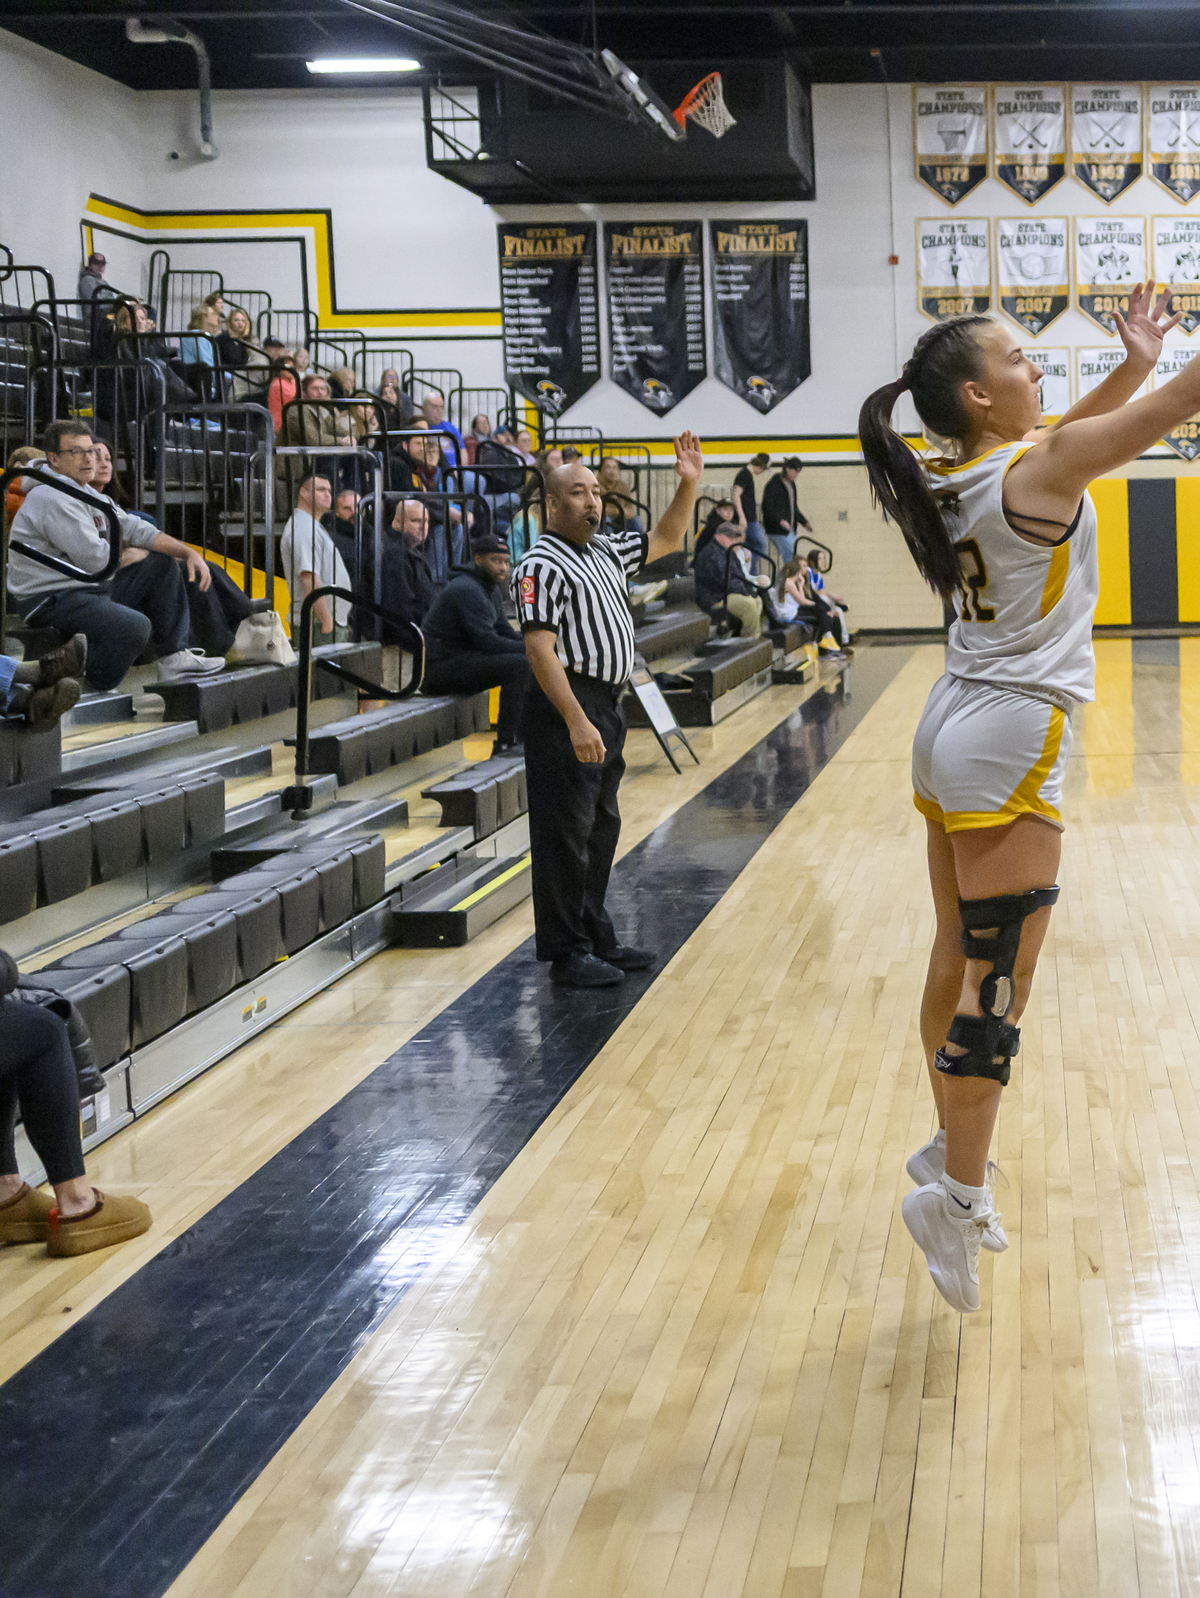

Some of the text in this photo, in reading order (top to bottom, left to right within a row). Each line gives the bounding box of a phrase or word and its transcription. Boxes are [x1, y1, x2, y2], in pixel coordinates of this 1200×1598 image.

[935, 91, 964, 100] STATE
[1014, 90, 1043, 100] STATE
[1091, 89, 1121, 99] STATE
[1169, 89, 1198, 99] STATE
[918, 101, 984, 116] CHAMPIONS
[997, 101, 1061, 115] CHAMPIONS
[1074, 100, 1138, 114] CHAMPIONS
[739, 224, 779, 234] STATE
[939, 223, 967, 233] STATE
[1018, 223, 1046, 232] STATE
[1096, 222, 1124, 231] STATE
[503, 234, 585, 256] FINALIST
[612, 232, 692, 254] FINALIST
[717, 230, 797, 252] FINALIST
[922, 234, 986, 249] CHAMPIONS
[1000, 233, 1064, 247] CHAMPIONS
[1078, 232, 1142, 246] CHAMPIONS
[938, 297, 974, 314] 2007
[1016, 297, 1053, 313] 2007
[1094, 296, 1130, 312] 2014
